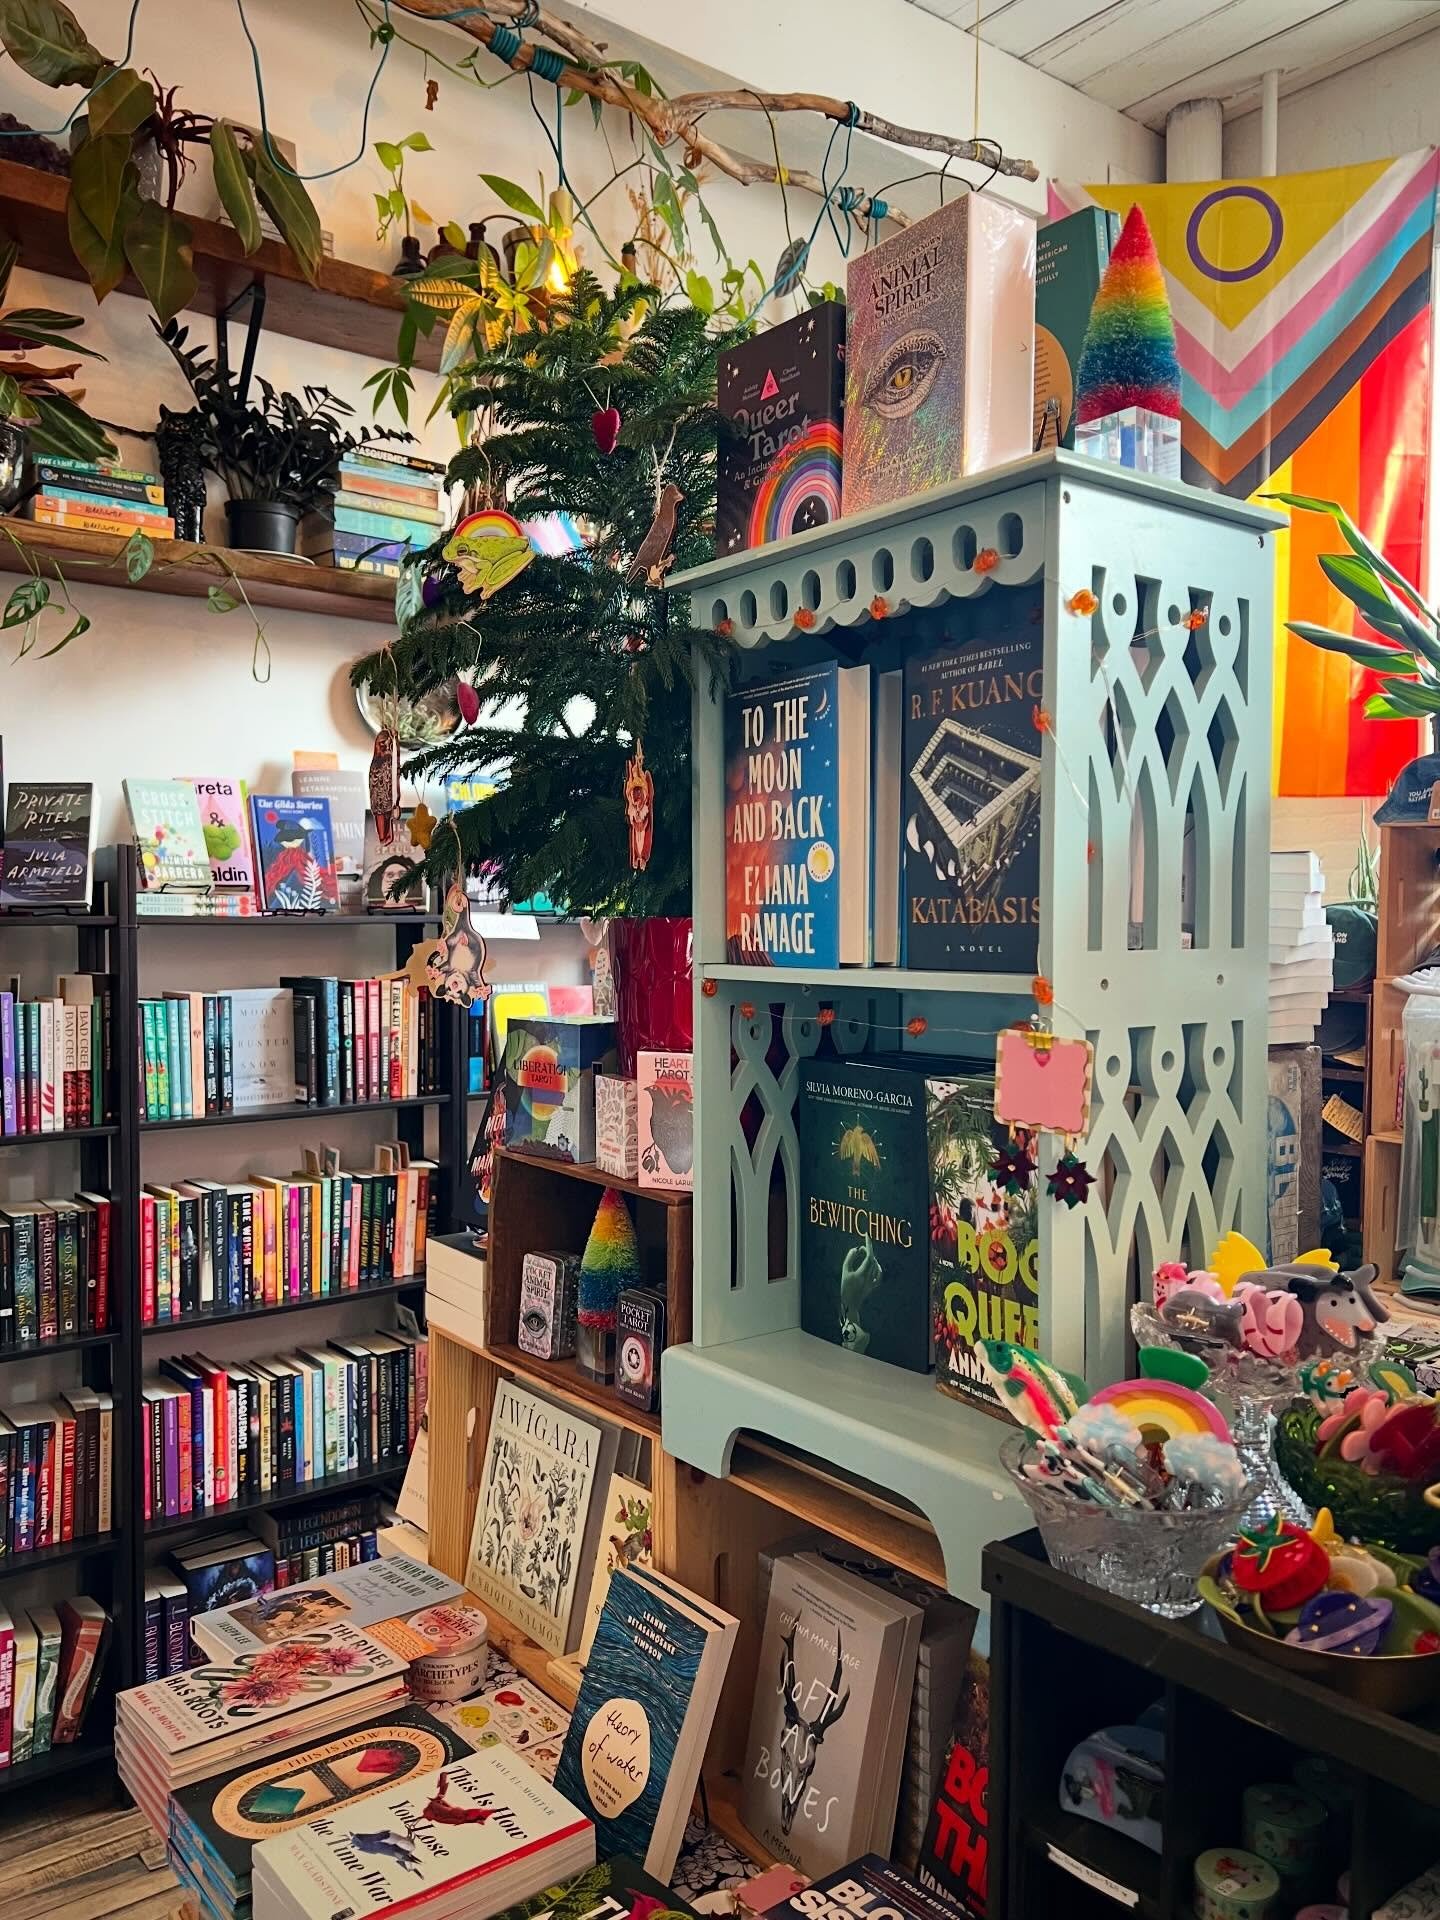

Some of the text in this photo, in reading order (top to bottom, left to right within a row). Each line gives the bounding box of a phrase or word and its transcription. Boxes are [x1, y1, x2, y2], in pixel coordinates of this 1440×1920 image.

[867, 246, 946, 303] ANIMAL
[875, 271, 934, 318] SPIRIT
[732, 391, 800, 439] Queer
[748, 413, 811, 461] Tarot
[929, 642, 1032, 671] NEW YORK TIMES BESTSELLING
[941, 659, 1003, 680] AUTHOR OF BABEL
[911, 693, 926, 720] R.
[932, 689, 945, 715] F.
[742, 696, 809, 749] TO THE
[749, 748, 802, 795] MOON
[13, 791, 88, 810] PRIVATE
[195, 782, 233, 796] reta
[258, 799, 323, 811] The Gilda Stories
[24, 811, 72, 830] RITES
[141, 808, 194, 827] STITCH
[209, 811, 226, 828] &
[733, 795, 824, 844] AND BACK
[7, 864, 84, 879] ARMFIELD
[24, 848, 67, 862] JULIA
[210, 867, 248, 881] aldin
[744, 864, 808, 906] ELIANA
[911, 896, 1040, 924] KATABASIS
[741, 912, 815, 954] RAMAGE
[959, 944, 1003, 953] NOVEL
[240, 1007, 278, 1016] MOON
[65, 1012, 74, 1068] BAD CREE
[80, 1011, 88, 1066] BAD CREE
[513, 1059, 571, 1077] LIBERATION
[531, 1074, 553, 1085] TAROT
[654, 1057, 690, 1070] HEART
[654, 1068, 690, 1081] TAROT
[4, 1077, 12, 1103] Collins
[806, 1081, 830, 1095] SILVIA
[832, 1085, 913, 1107] MORENO-GARCIA
[652, 1178, 674, 1186] NICOLE
[847, 1185, 868, 1202] THE
[242, 1195, 251, 1265] LONE WOMEN
[809, 1197, 913, 1248] BEWITCHING
[19, 1231, 29, 1293] FIFTH SEASON
[44, 1229, 52, 1267] OBELISK
[64, 1235, 72, 1286] STONE SKY
[525, 1266, 552, 1280] POCKET
[525, 1276, 552, 1290] ANIMAL
[41, 1293, 49, 1322] JEMISIN
[526, 1285, 549, 1299] SPIRIT
[15, 1295, 26, 1324] JEMISIN
[621, 1304, 651, 1322] POCKET
[623, 1314, 649, 1331] TAROT
[943, 1281, 1039, 1348] QUEE
[64, 1426, 74, 1467] LUCKY RED
[499, 1393, 592, 1469] IWÍGARA
[239, 1473, 246, 1481] Fu
[19, 1508, 28, 1534] Nightfall
[368, 1564, 426, 1597] OF THIS LAND
[384, 1556, 450, 1590] NOTHING MORE
[471, 1571, 514, 1612] ENRIQUE
[627, 1615, 676, 1656] BETASAMOSAKE
[642, 1611, 668, 1633] LEANNE
[328, 1623, 356, 1643] THE
[352, 1637, 394, 1670] RIVER
[633, 1635, 662, 1661] SIMPSON
[778, 1610, 861, 1671] CHYANA MARIE SAGE
[164, 1674, 229, 1730] HAS ROOTS
[777, 1661, 839, 1725] SOFT
[134, 1689, 187, 1743] AMAL EL-MOHTAR
[606, 1710, 642, 1745] theory
[285, 1729, 440, 1768] THIS IS HOW YOU LOSE
[589, 1734, 643, 1784] of water
[781, 1722, 816, 1765] AS
[444, 1765, 527, 1841] This Is How
[489, 1758, 556, 1817] AMAL EL-MOHTAR
[753, 1747, 839, 1833] BONES
[388, 1799, 450, 1858] You Lose
[289, 1845, 344, 1908] MAX GLADSTONE
[307, 1817, 395, 1905] the Time War
[883, 1869, 928, 1899] USA TODAY
